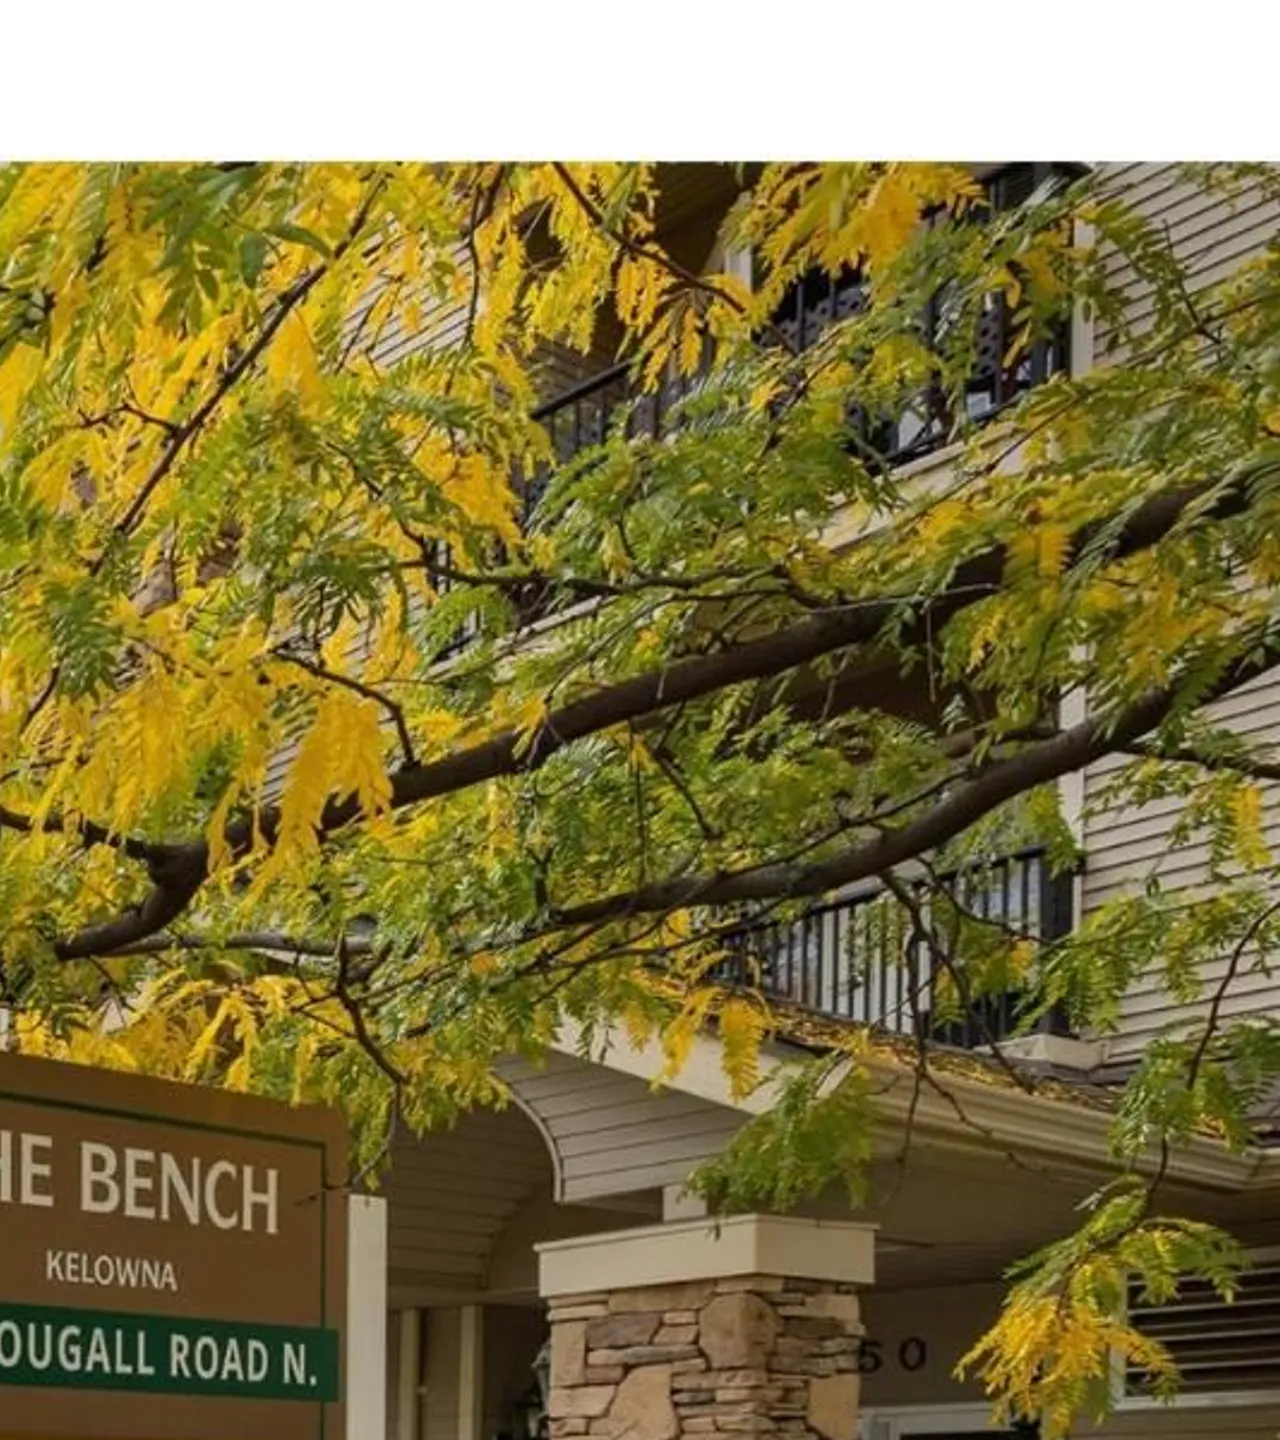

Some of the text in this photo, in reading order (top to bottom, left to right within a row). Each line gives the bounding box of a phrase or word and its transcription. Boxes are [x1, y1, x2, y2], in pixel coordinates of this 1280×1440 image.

[80, 1140, 280, 1235] BENCH
[45, 1249, 179, 1292] KELOWNA
[169, 1332, 270, 1383] ROAD
[282, 1341, 318, 1387] N.
